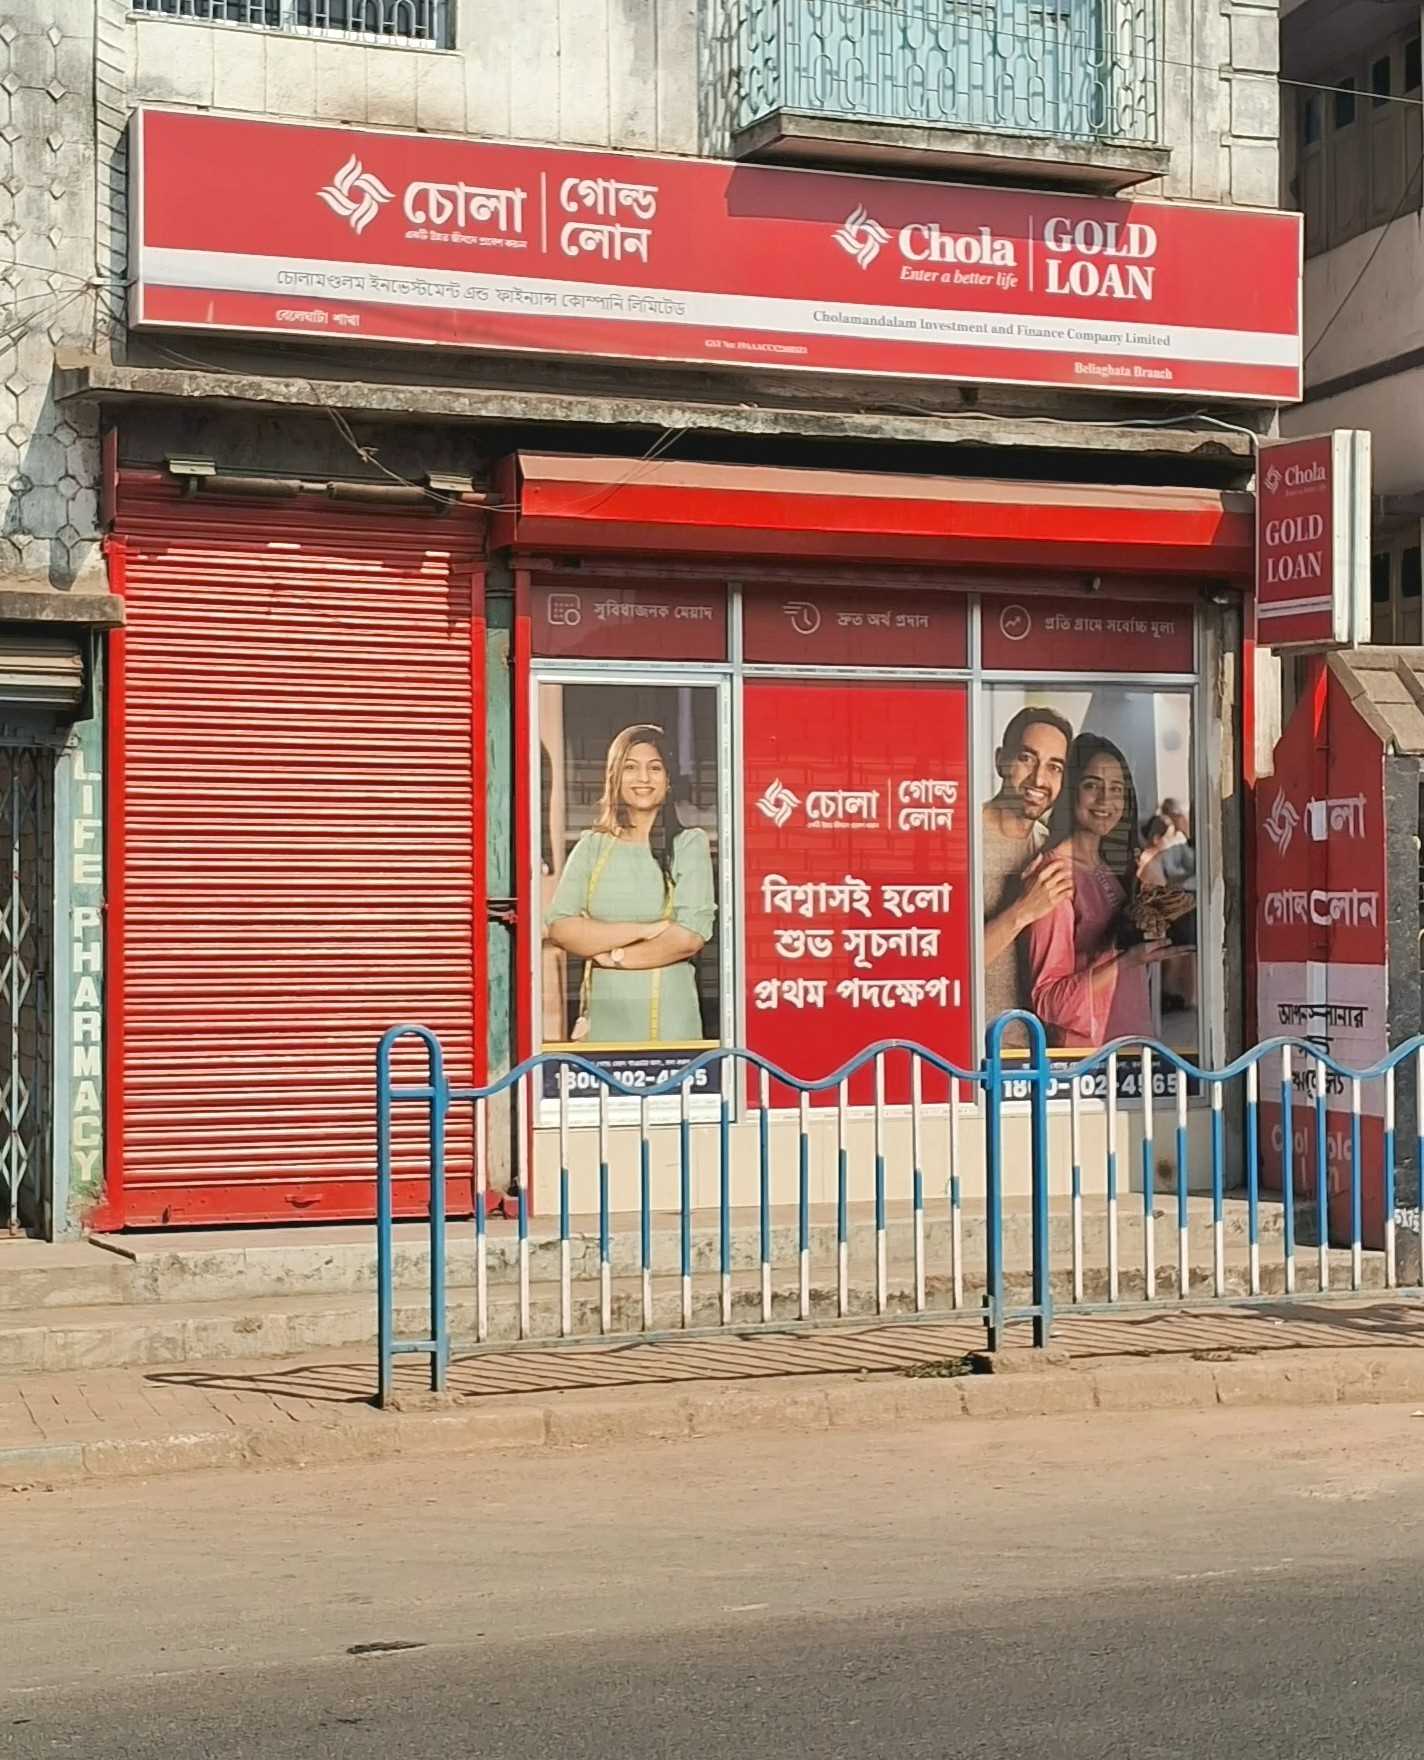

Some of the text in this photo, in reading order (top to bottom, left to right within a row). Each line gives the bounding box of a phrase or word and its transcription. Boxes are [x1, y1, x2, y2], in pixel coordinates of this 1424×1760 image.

[404, 181, 527, 233] চোলা
[560, 177, 658, 219] গোল্ড
[560, 222, 652, 263] লোন
[898, 223, 1018, 267] Chola
[1043, 216, 1158, 259] GOLD
[900, 265, 1019, 290] Enter a better life
[1045, 258, 1156, 300] LOAN
[627, 295, 688, 316] লিমিটেড
[813, 310, 1171, 346] Cholamandalam Investment and Finance Company Limited
[1133, 365, 1173, 380] Branch
[1284, 461, 1327, 487] Chola
[1265, 513, 1323, 546] GOLD
[1266, 551, 1323, 583] LOAN
[805, 789, 880, 820] চোলা
[898, 779, 959, 805] গোল্ড
[898, 806, 955, 832] লোন
[761, 873, 953, 919] বিশ্বাসই হলো
[774, 925, 941, 969] শুভ সূচনার
[73, 750, 102, 1182] LIFE PHARMACY
[753, 976, 961, 1010] প্রথম পদক্ষেপ।
